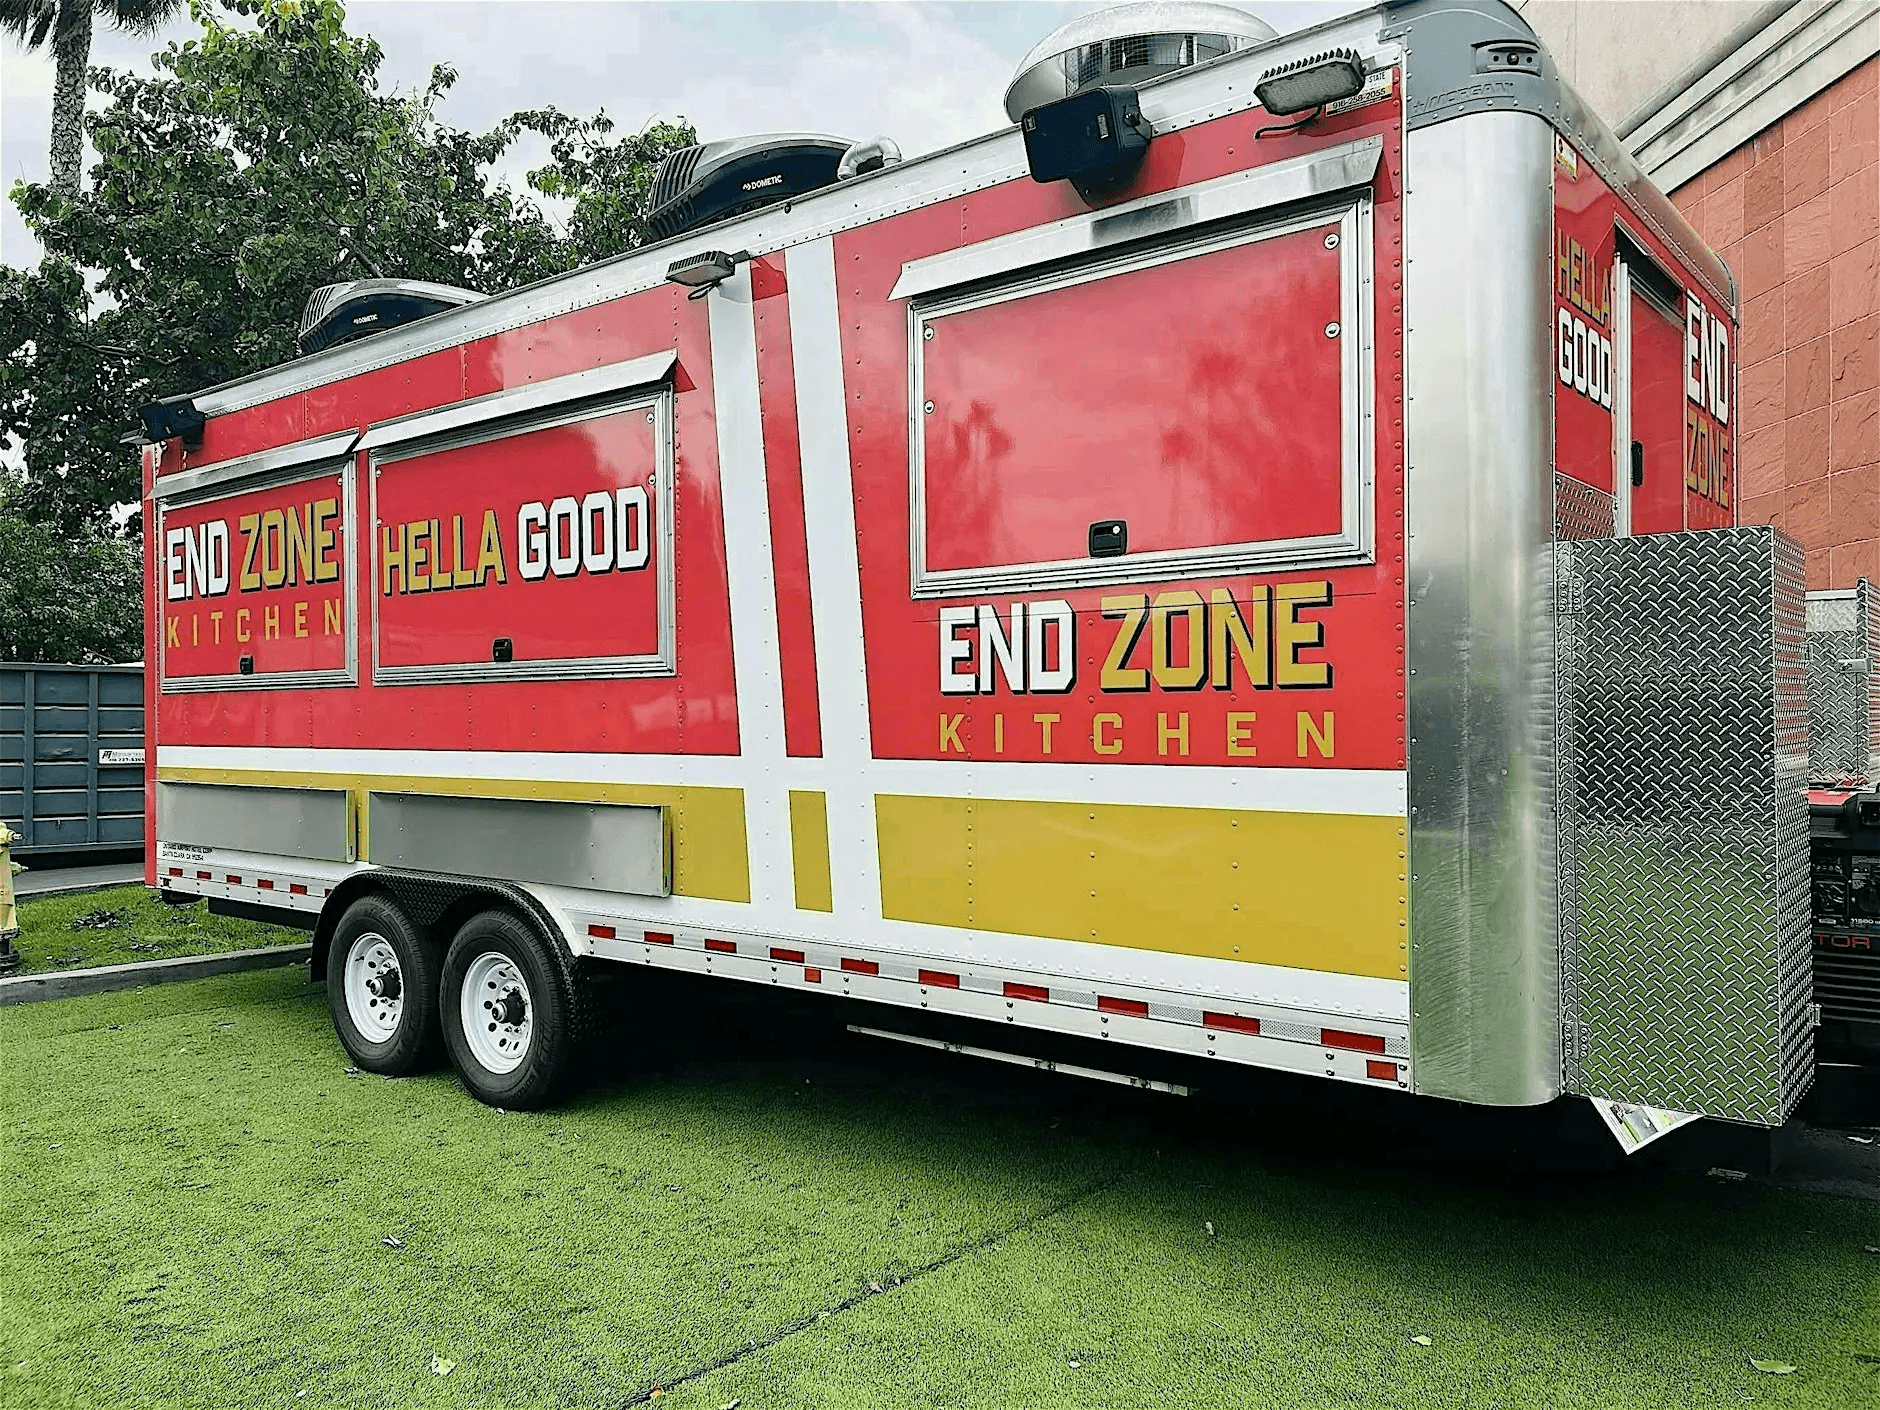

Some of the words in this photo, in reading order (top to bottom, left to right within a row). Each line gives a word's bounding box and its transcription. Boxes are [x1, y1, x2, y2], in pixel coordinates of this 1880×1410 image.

[751, 174, 783, 190] DOMETIC
[1557, 226, 1612, 334] HELLA
[1558, 306, 1612, 412] GOOD
[1686, 289, 1730, 429] END
[1687, 408, 1729, 511] ZONE
[166, 519, 231, 602] END
[239, 497, 340, 594] ZONE
[382, 509, 508, 597] HELLA
[517, 484, 652, 582] GOOD
[167, 598, 341, 648] KITCHEN
[939, 599, 1076, 695] END
[1100, 580, 1333, 693] ZONE
[939, 711, 1335, 758] KITCHEN
